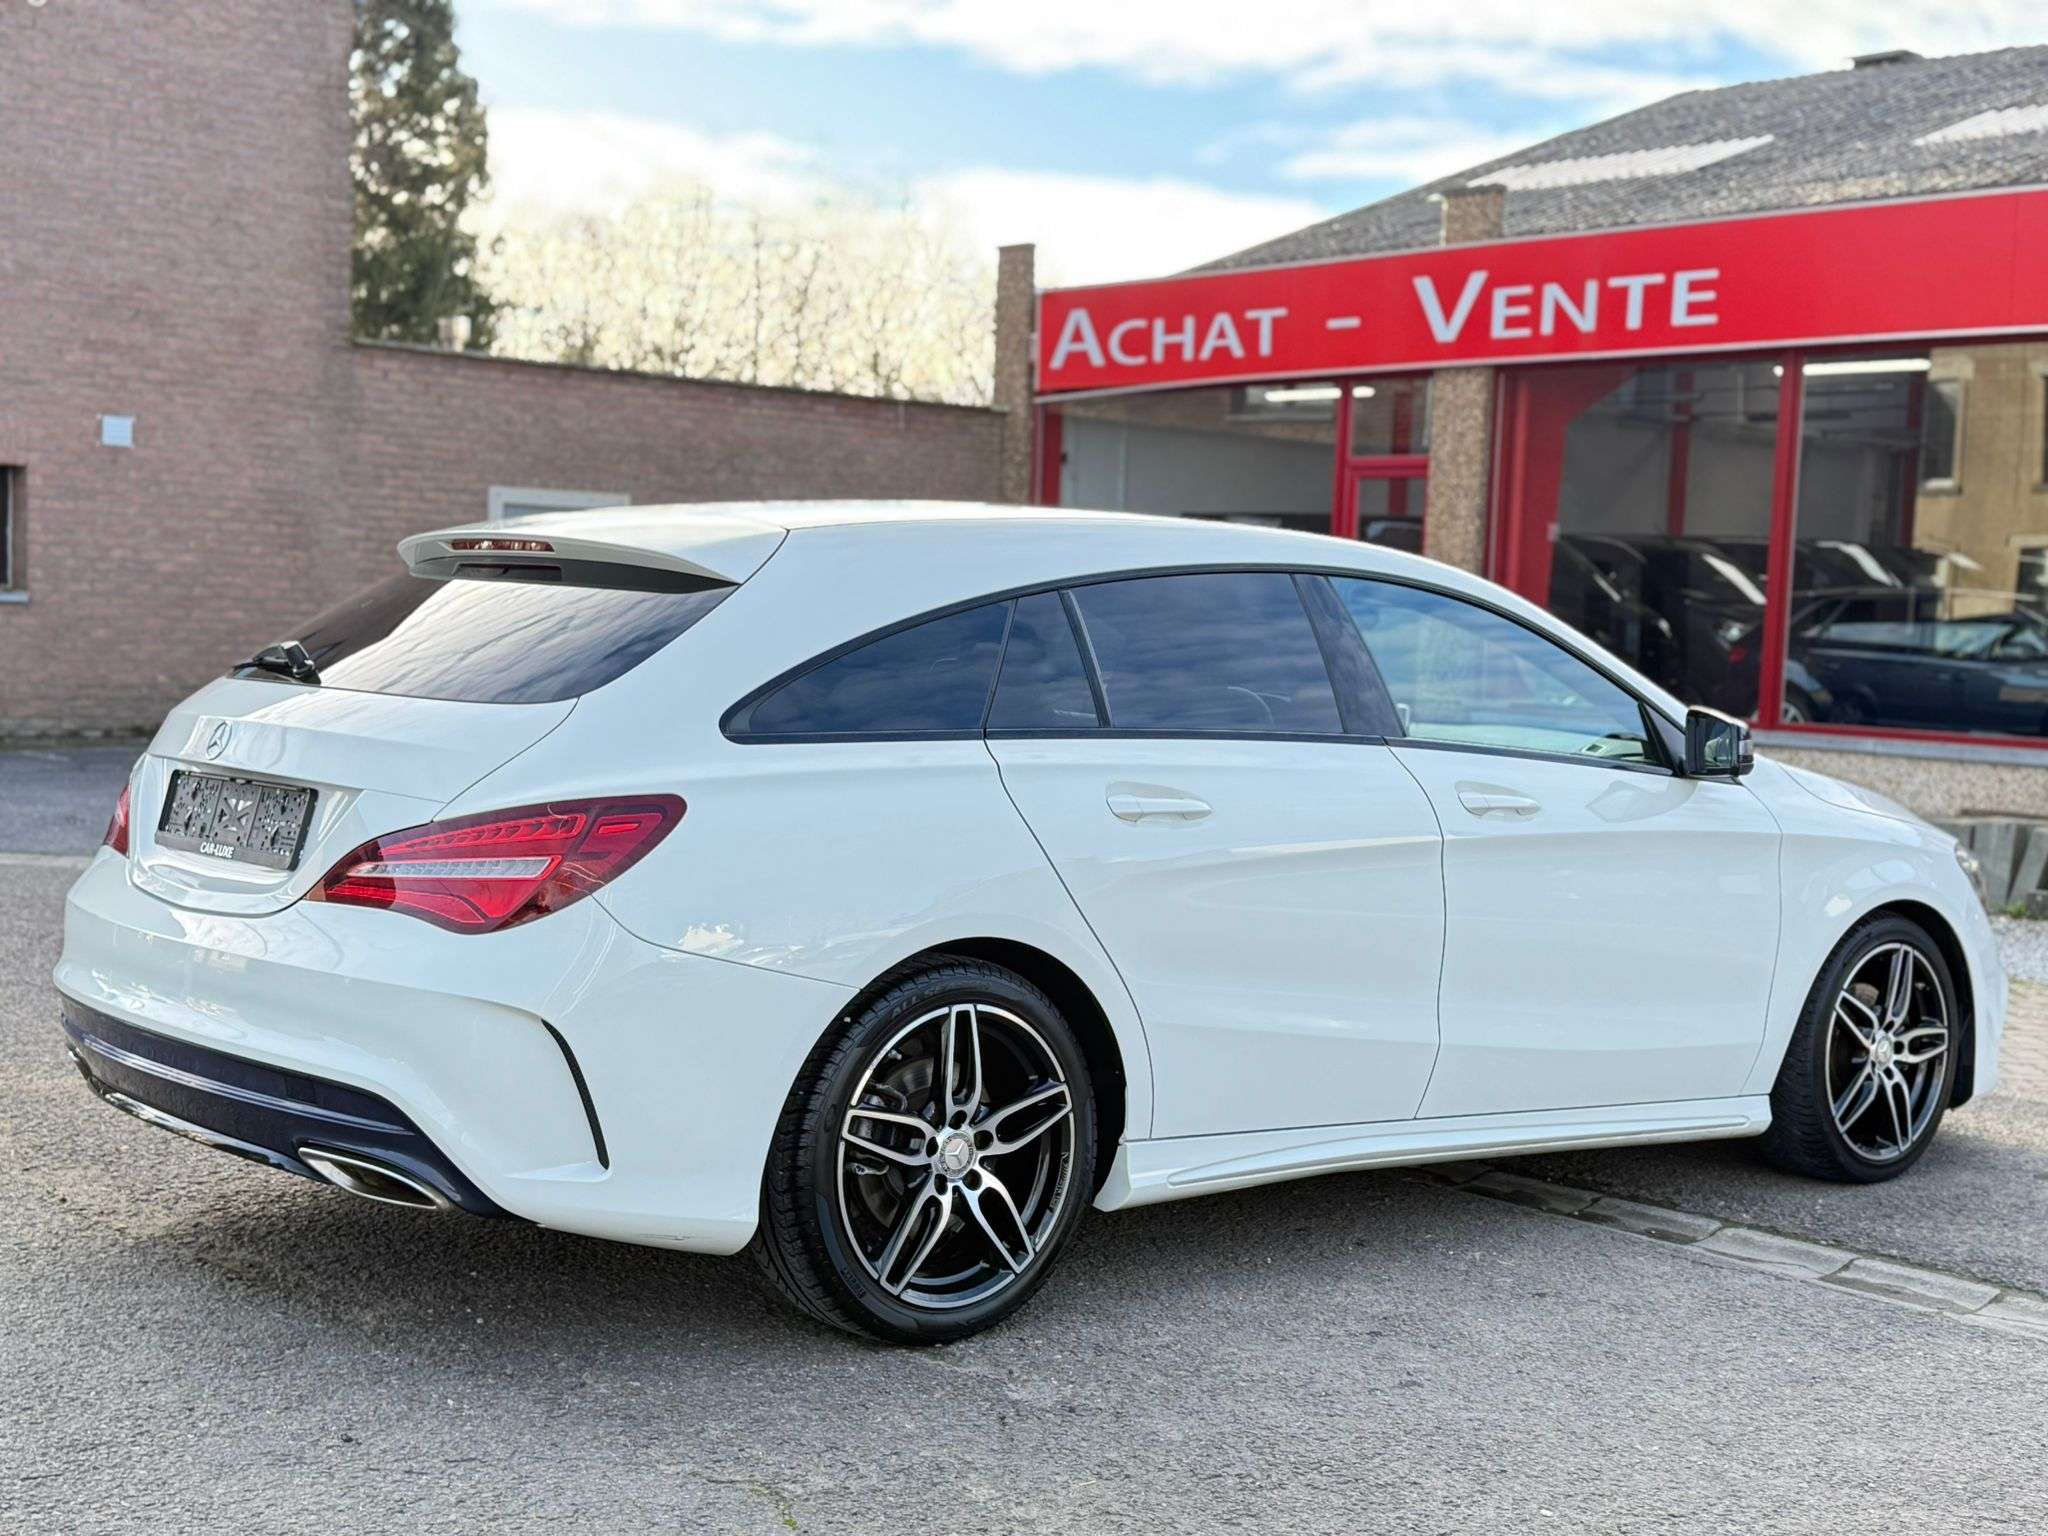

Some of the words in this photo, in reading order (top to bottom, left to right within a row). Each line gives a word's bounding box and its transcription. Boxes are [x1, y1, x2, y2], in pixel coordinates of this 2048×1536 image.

[1049, 307, 1288, 370] ACHAT
[1326, 316, 1361, 330] -
[1413, 268, 1720, 343] VENTE
